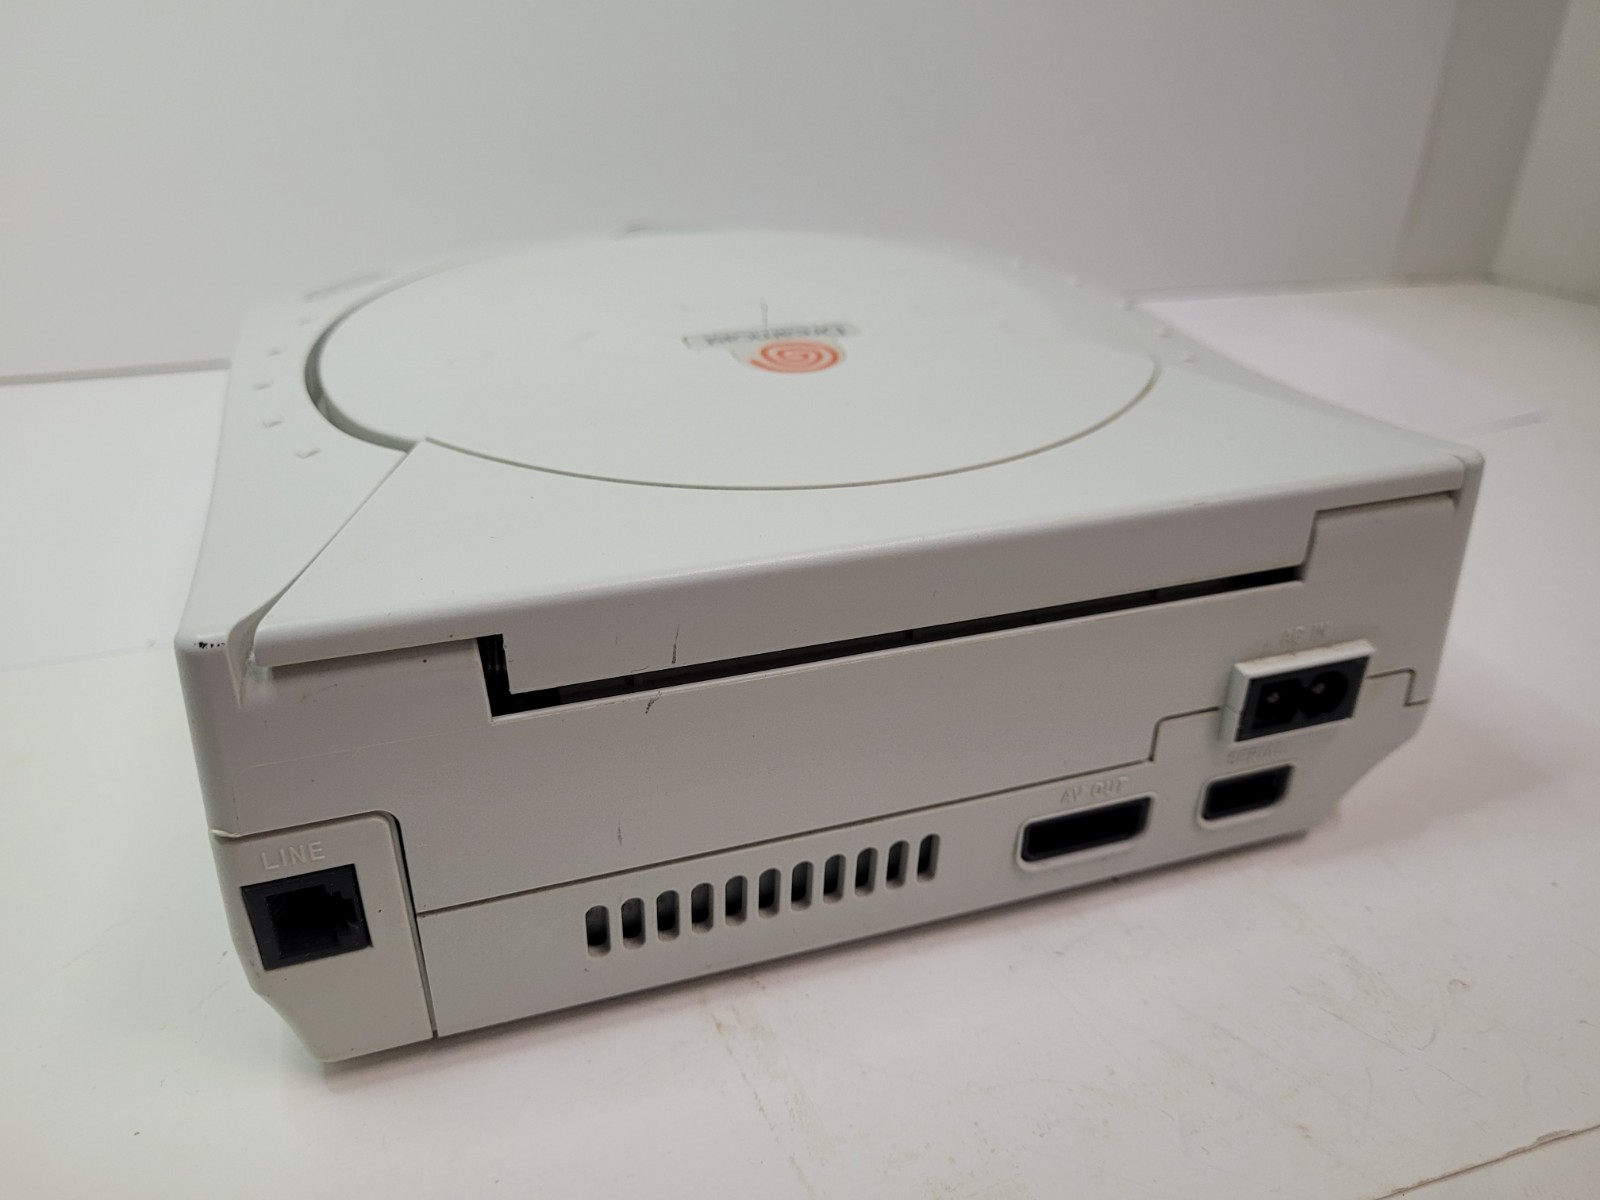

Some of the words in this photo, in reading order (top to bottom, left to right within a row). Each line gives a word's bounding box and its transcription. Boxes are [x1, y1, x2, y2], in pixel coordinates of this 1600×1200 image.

[1059, 784, 1086, 804] AV
[1089, 775, 1129, 800] OUT
[260, 840, 326, 871] LINE
